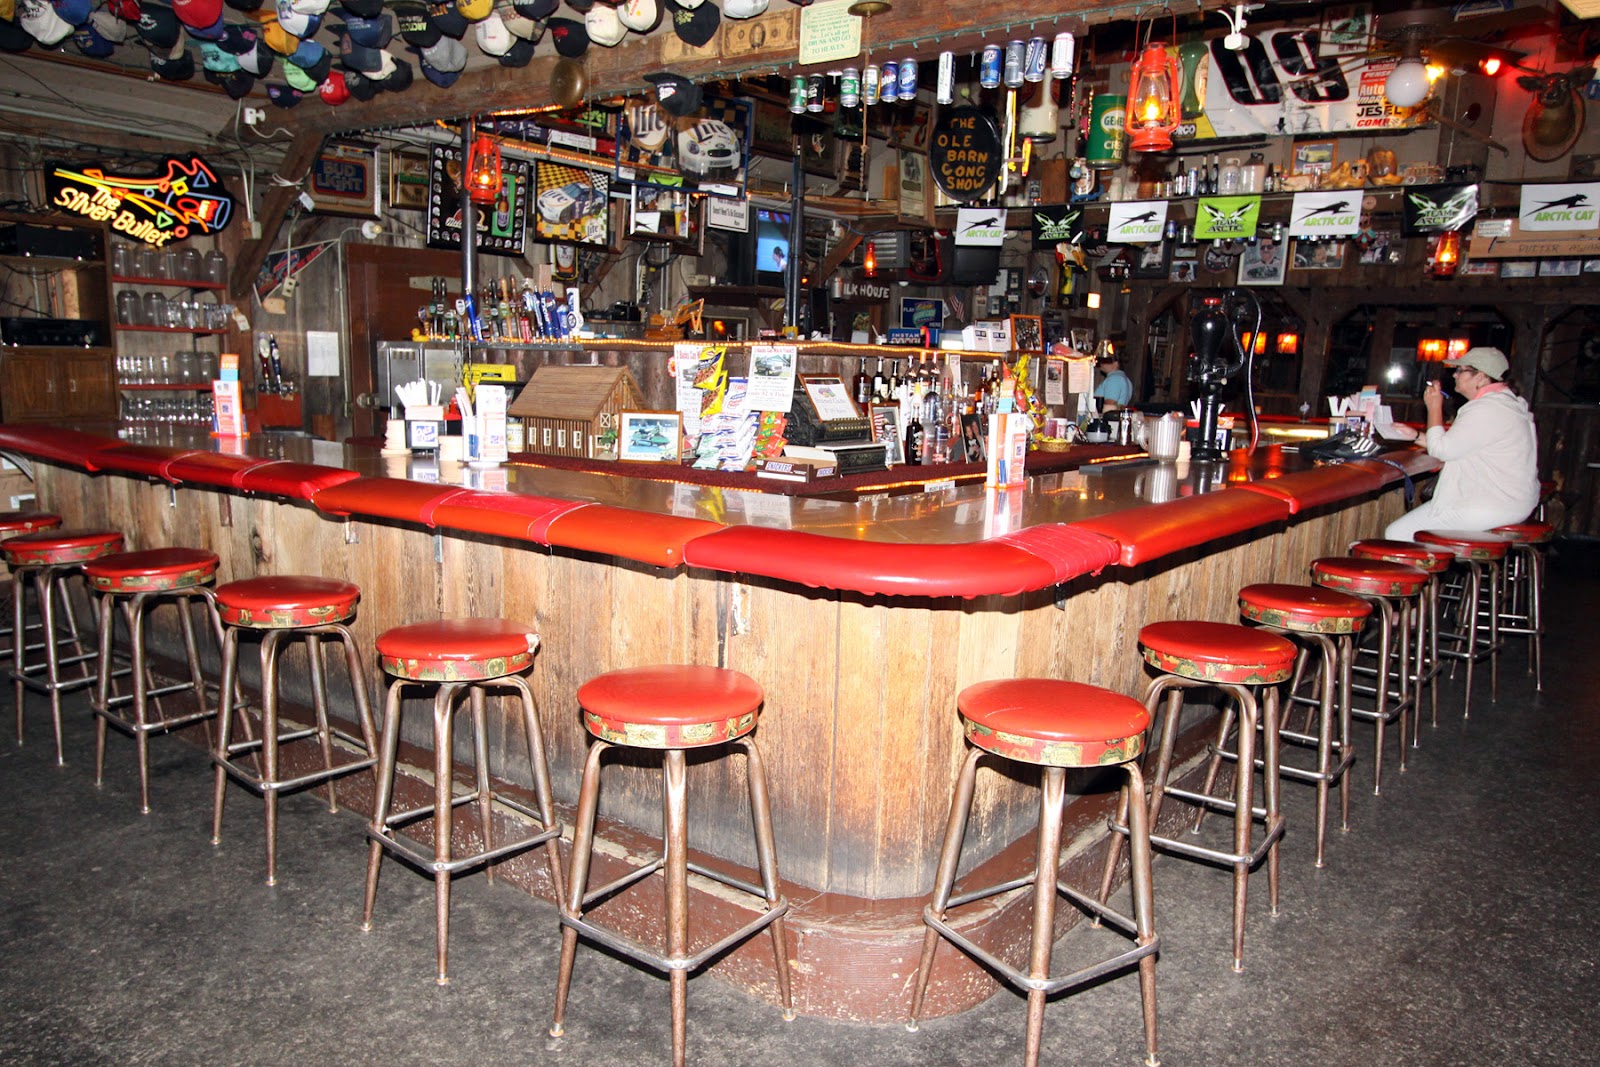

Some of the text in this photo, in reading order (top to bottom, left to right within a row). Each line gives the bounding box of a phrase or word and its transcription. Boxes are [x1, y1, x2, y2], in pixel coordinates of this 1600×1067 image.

[808, 38, 827, 47] DRUNK
[821, 43, 845, 53] HEAVEN
[1357, 105, 1402, 117] JESEL
[634, 104, 666, 138] Lite
[951, 117, 976, 129] THE
[1357, 118, 1390, 127] COMP
[696, 119, 728, 143] Lite
[937, 134, 972, 147] OLE
[947, 149, 988, 163] BARN
[323, 162, 356, 176] BUD
[317, 174, 362, 192] LIGHT
[946, 176, 985, 191] SHOW
[92, 185, 121, 212] The
[53, 187, 174, 247] Silver Bullet
[1424, 210, 1453, 218] TEAM
[1534, 210, 1596, 222] ARCTIC CAT
[1303, 215, 1356, 227] ARCTIC CAT
[587, 225, 599, 237] Lite
[966, 230, 989, 238] ARCTIC
[1120, 224, 1162, 234] ARCTIC CAT
[843, 283, 890, 299] ILK HOUSE
[766, 463, 792, 472] SNICKERS
